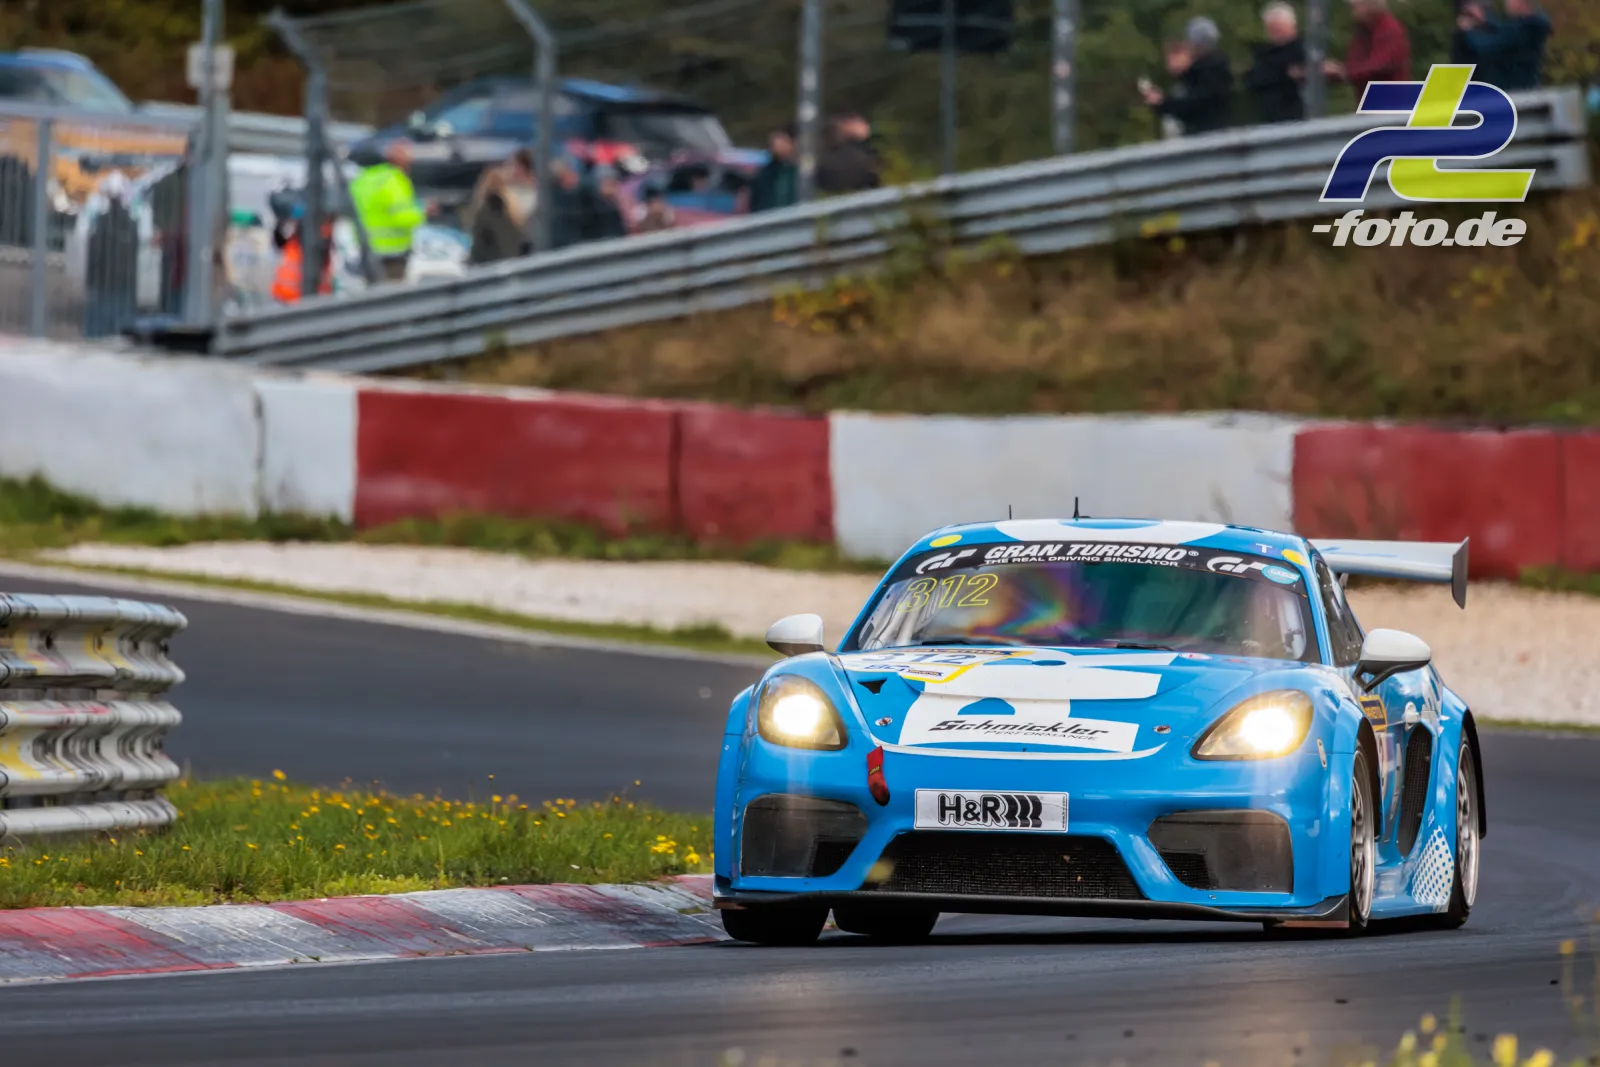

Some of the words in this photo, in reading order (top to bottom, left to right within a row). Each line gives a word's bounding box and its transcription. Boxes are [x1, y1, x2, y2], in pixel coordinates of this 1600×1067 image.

[984, 544, 1063, 560] GRAN
[1103, 557, 1180, 568] SIMULATOR
[897, 573, 999, 612] 312
[861, 652, 977, 664] 312
[928, 720, 1110, 736] Schmickler
[984, 730, 1099, 741] PERFORMANCE
[938, 793, 1006, 827] H&R
